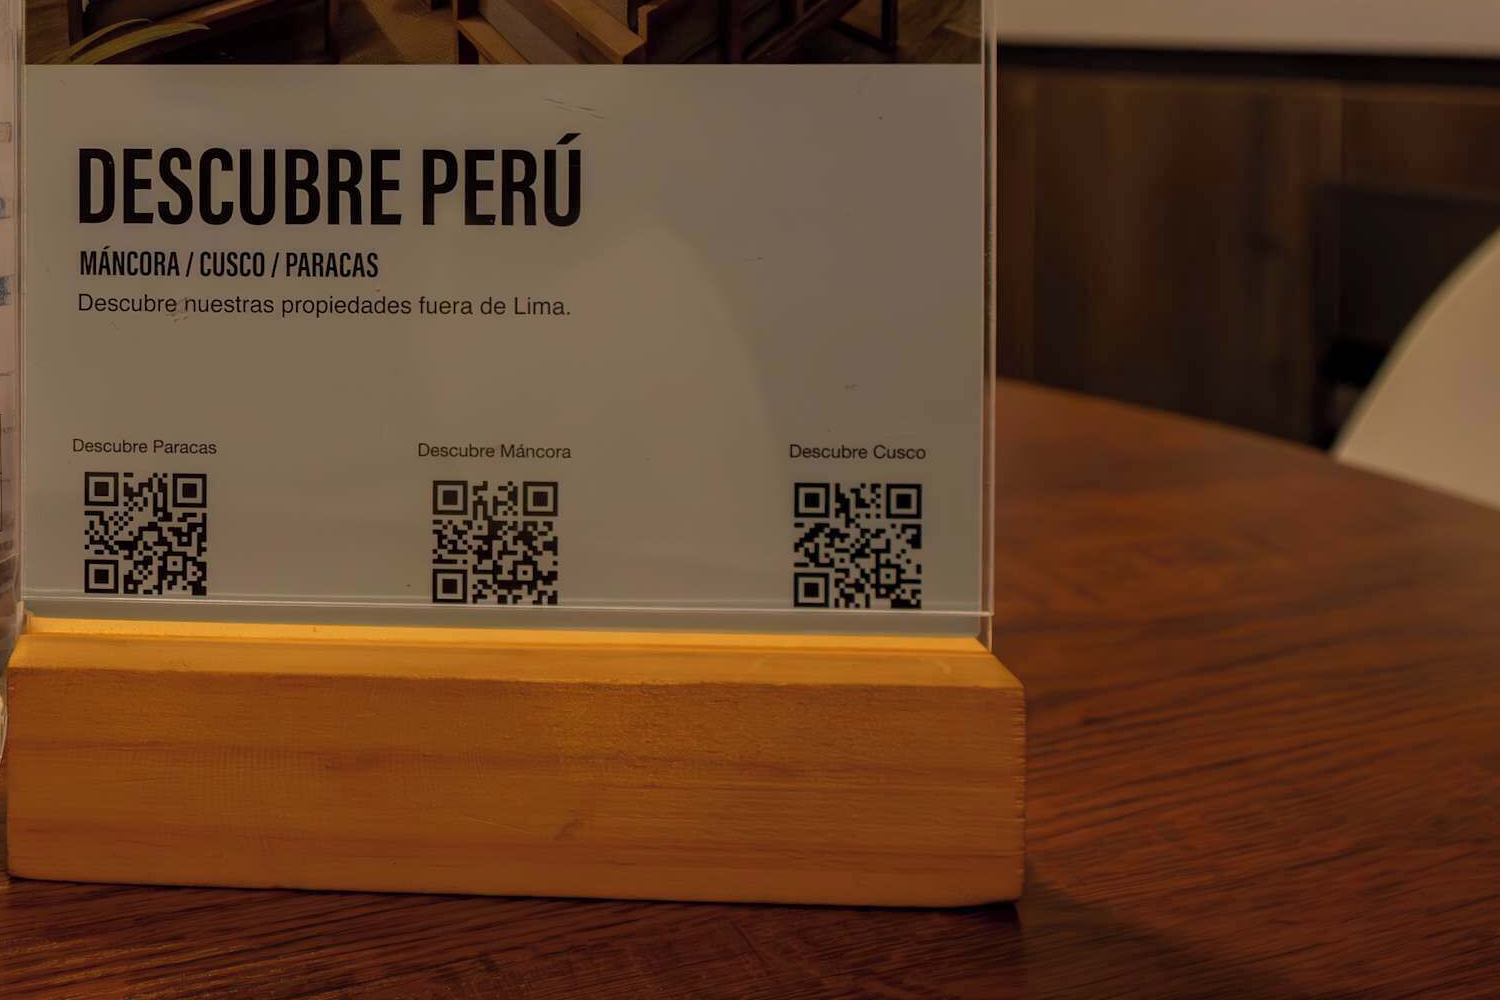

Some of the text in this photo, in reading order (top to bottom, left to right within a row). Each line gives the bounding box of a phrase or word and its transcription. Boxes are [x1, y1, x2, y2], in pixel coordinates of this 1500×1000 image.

[78, 147, 402, 226] DESCUBRE
[422, 133, 582, 228] PERÚ
[80, 245, 180, 277] MÁNCORA
[200, 252, 265, 278] CUSCO
[286, 252, 379, 278] PARACAS
[78, 294, 571, 319] Descubre nuestras propiedades fuera de Lima.
[72, 438, 217, 454] Descubre Paracas
[418, 442, 572, 458] Descubre Máncora
[789, 443, 927, 459] Descubre Cusco
